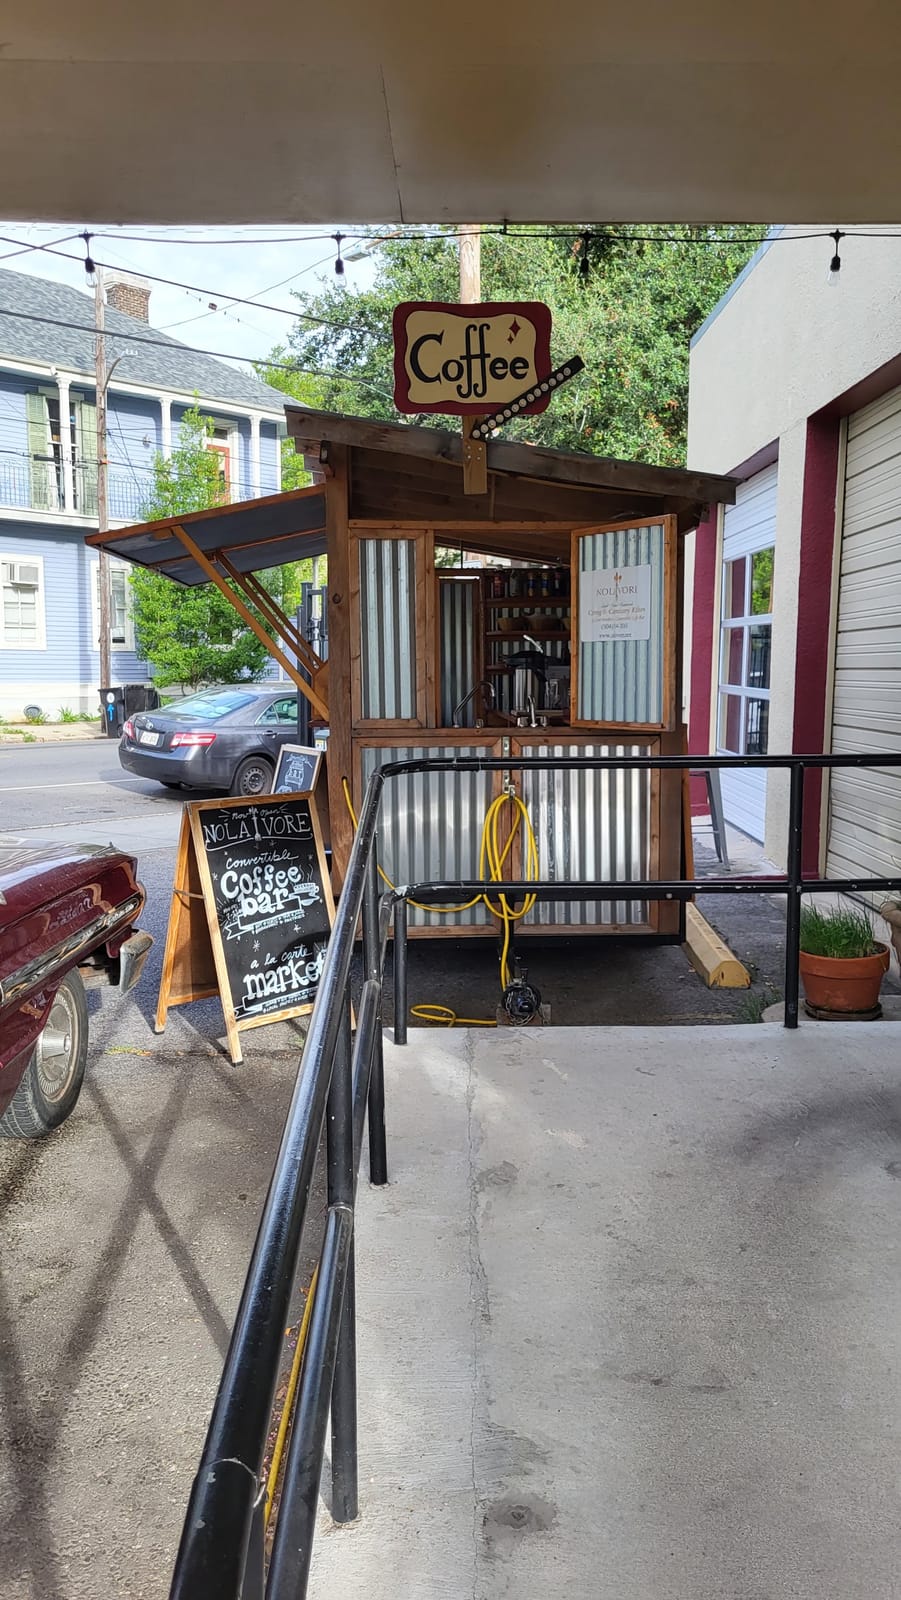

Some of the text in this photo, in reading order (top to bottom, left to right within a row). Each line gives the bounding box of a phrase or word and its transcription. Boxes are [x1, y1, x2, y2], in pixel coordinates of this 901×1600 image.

[409, 323, 530, 399] Coffee
[220, 864, 302, 899] Coffee
[237, 887, 289, 916] bar
[250, 944, 313, 969] a la carte
